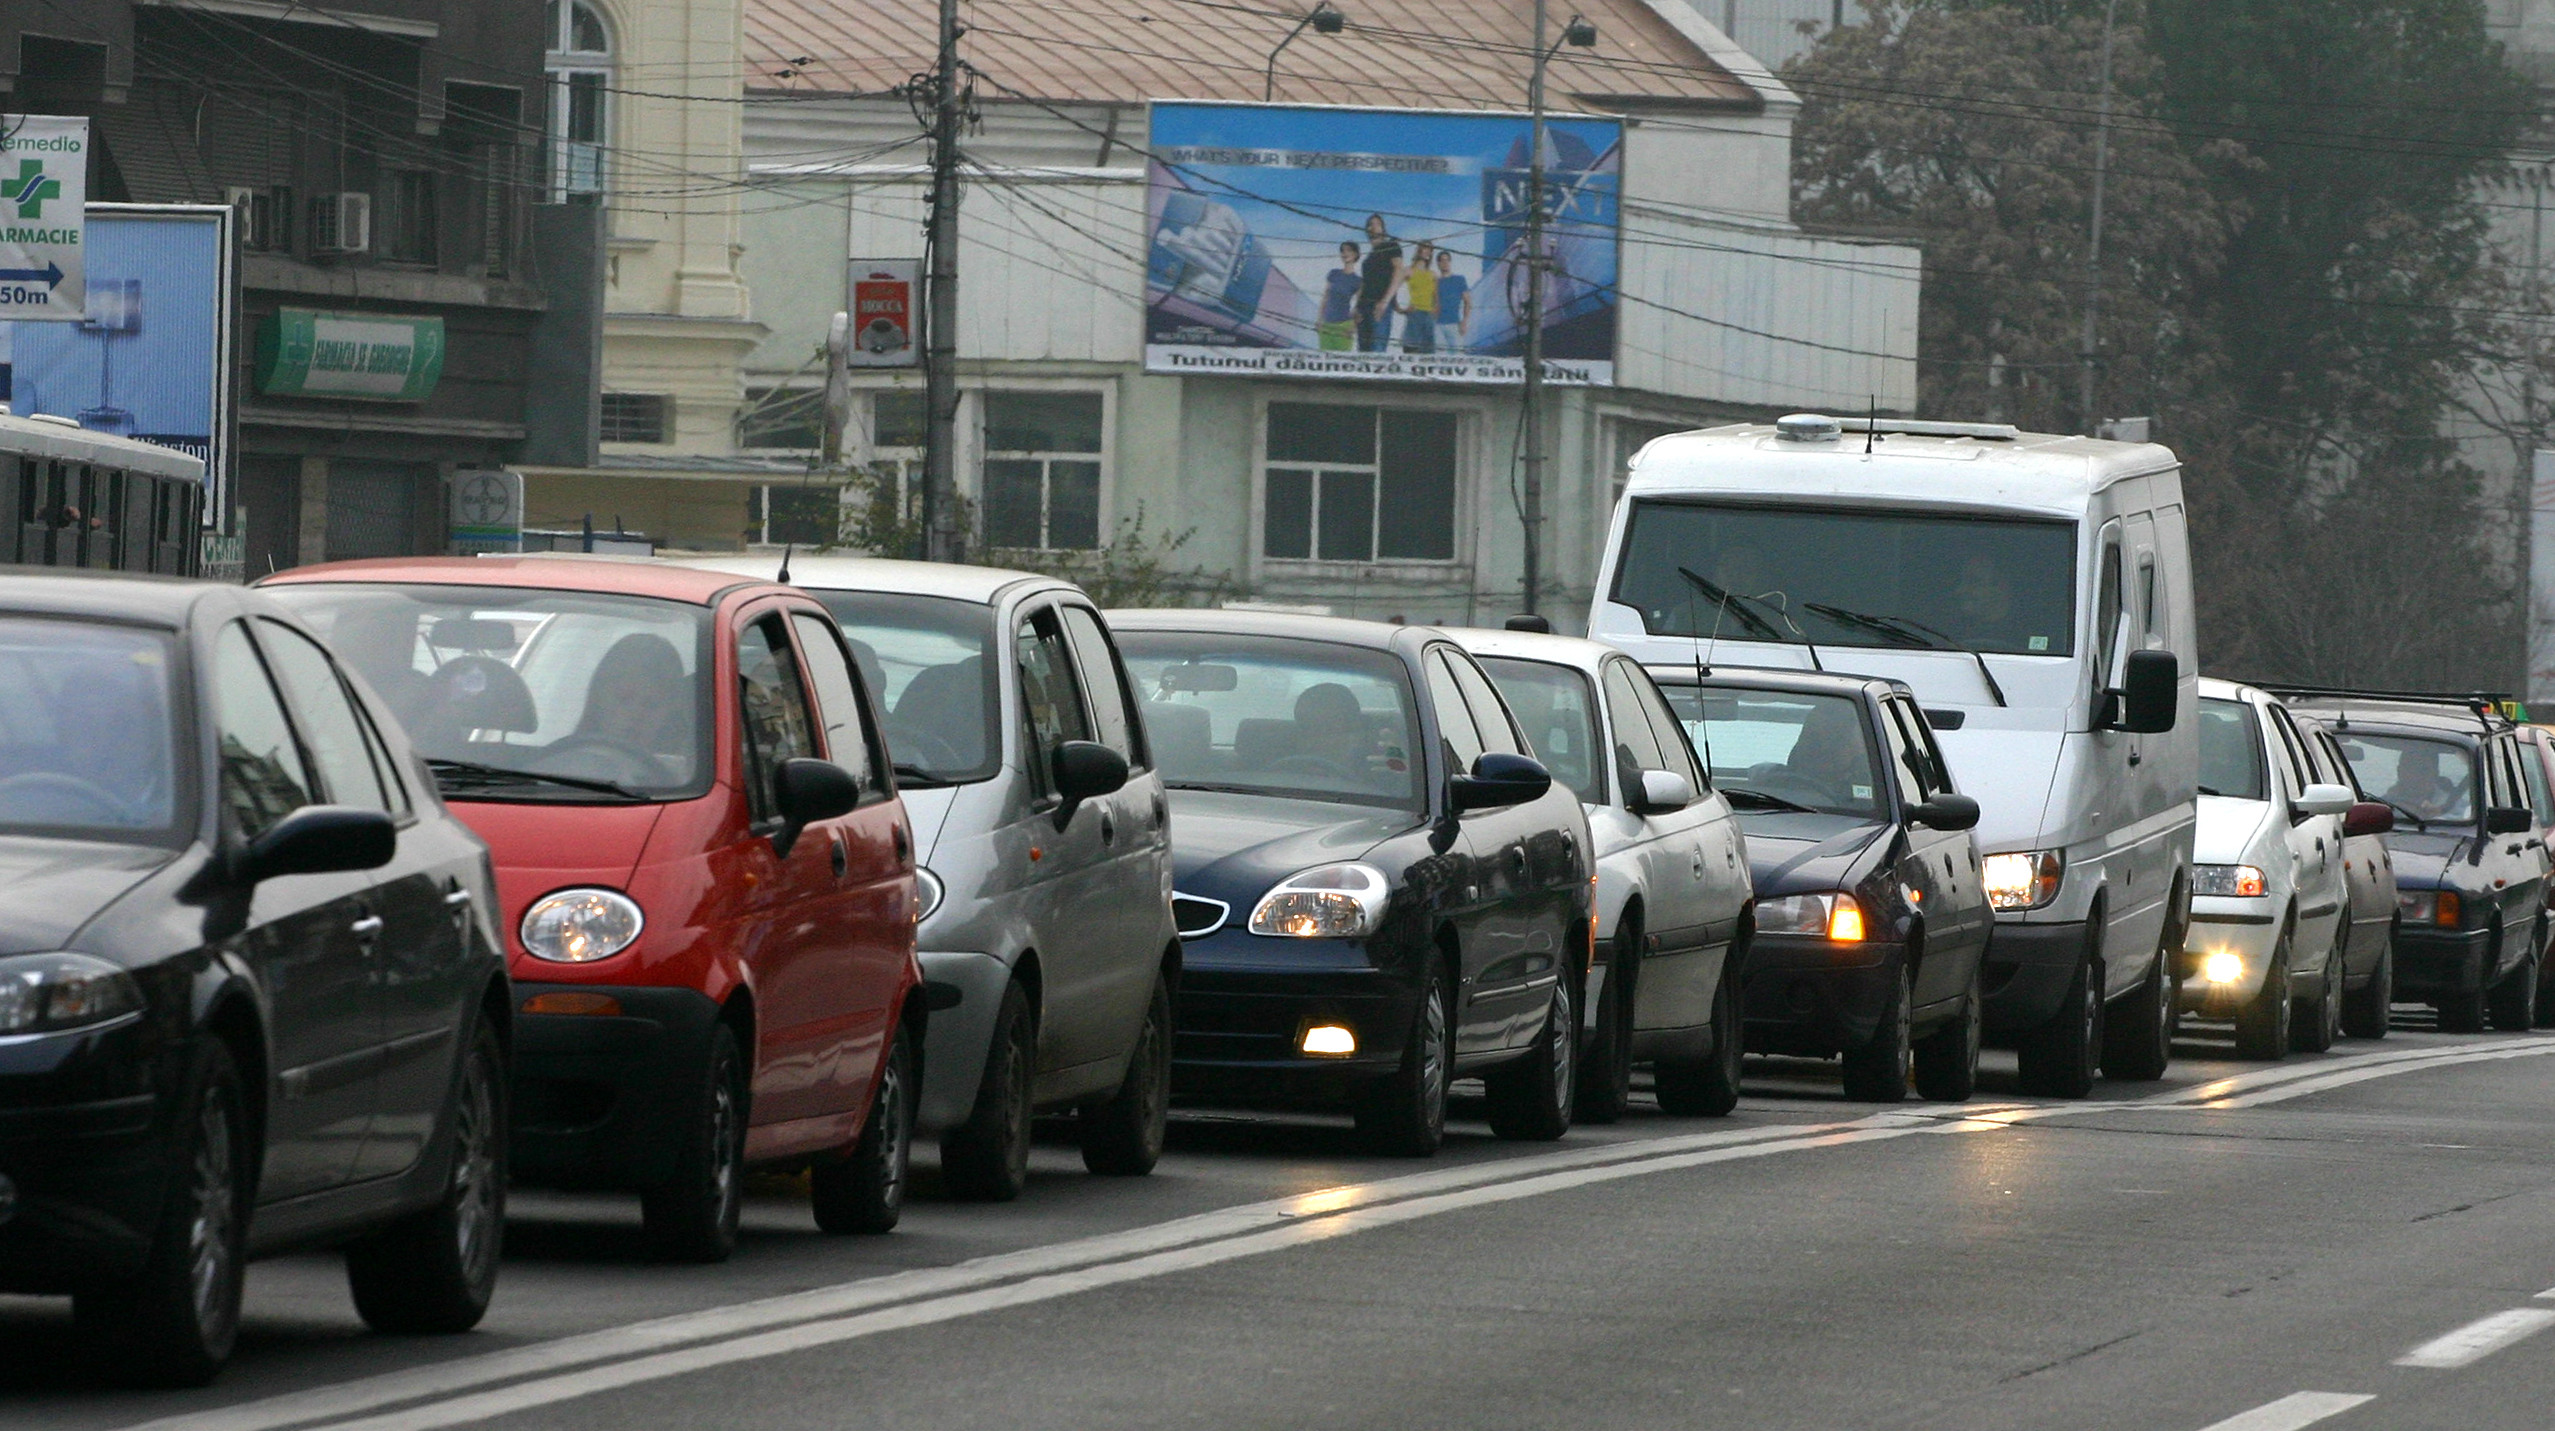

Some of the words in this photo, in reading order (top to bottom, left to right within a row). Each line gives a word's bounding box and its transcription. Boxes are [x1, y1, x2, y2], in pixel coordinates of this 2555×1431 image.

[3, 136, 81, 152] emedio
[1240, 150, 1279, 165] YOUR
[1168, 352, 1266, 369] Tutunul
[1410, 364, 1468, 377] grav
